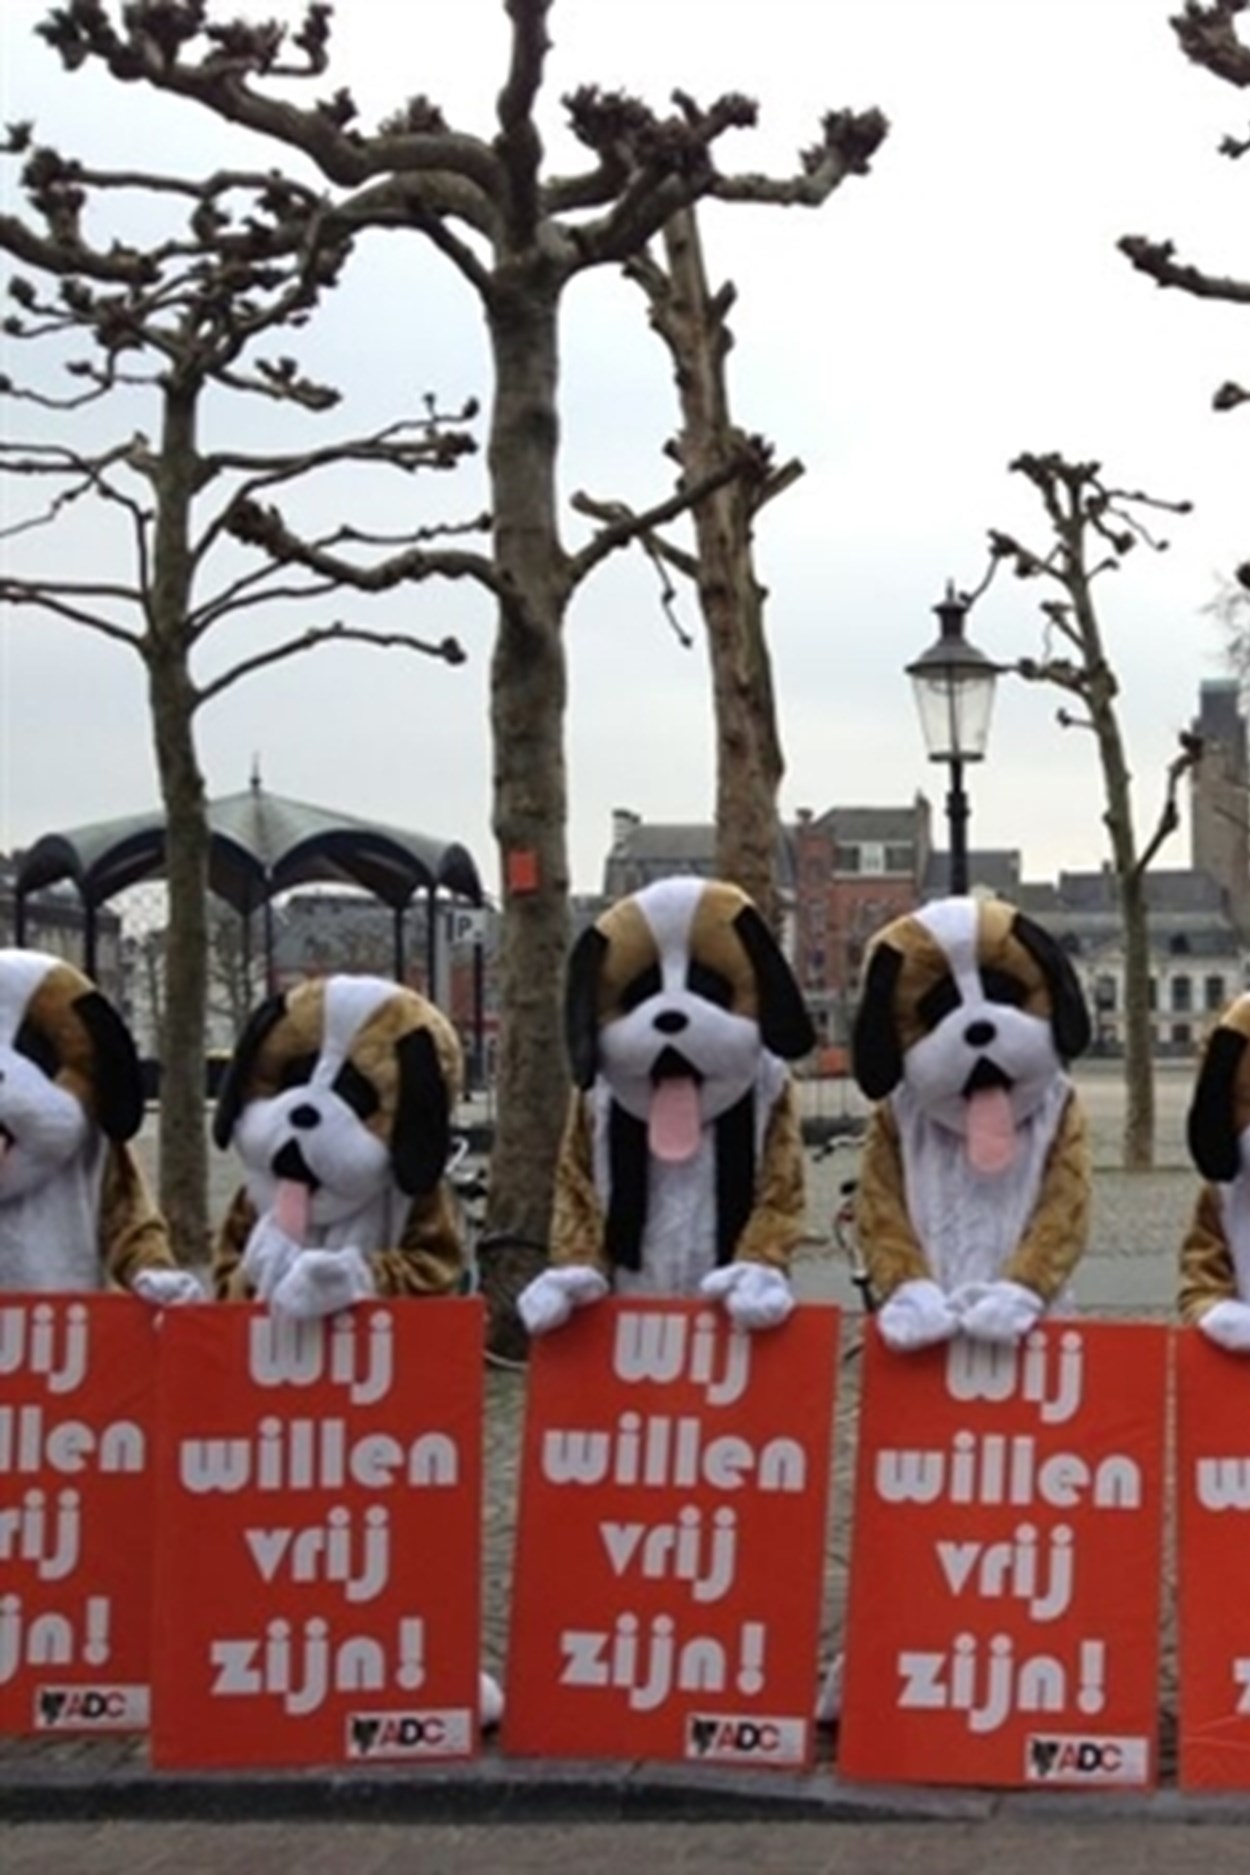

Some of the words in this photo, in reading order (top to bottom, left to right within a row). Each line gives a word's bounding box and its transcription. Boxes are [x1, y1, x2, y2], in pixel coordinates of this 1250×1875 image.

[613, 1311, 750, 1406] Wij
[180, 1416, 458, 1493] willen
[542, 1411, 807, 1492] willen
[875, 1429, 1142, 1510] willen
[245, 1505, 389, 1602] vrij
[599, 1504, 737, 1603] vrij
[935, 1521, 1074, 1622] vrij
[210, 1617, 425, 1715] zijn!
[560, 1612, 766, 1711] zijn!
[897, 1631, 1106, 1734] zijn!
